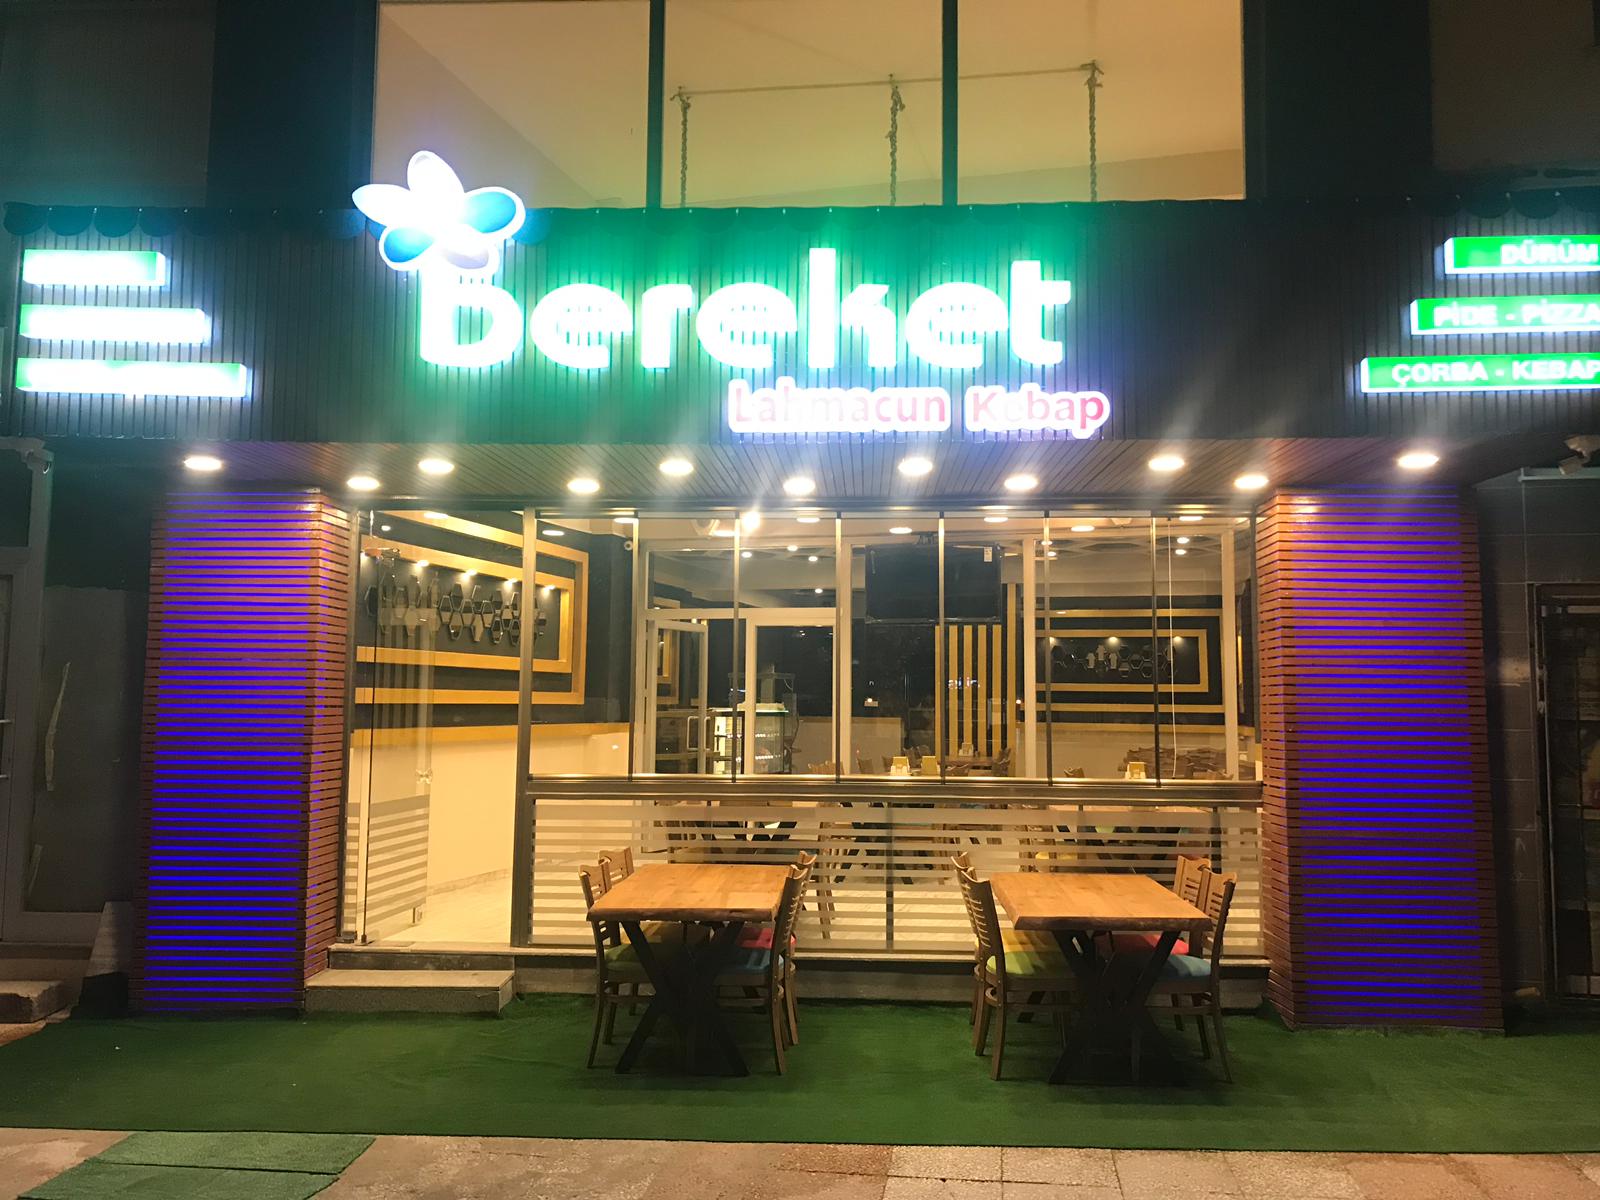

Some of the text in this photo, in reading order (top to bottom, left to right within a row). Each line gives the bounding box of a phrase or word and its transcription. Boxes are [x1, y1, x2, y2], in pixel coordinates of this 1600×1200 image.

[1500, 239, 1599, 265] DÜRÜM
[419, 248, 1073, 370] bereket
[1433, 301, 1498, 327] PİDE
[1520, 299, 1600, 326] PİZZA
[1391, 361, 1489, 388] ÇORBA
[734, 384, 1106, 431] Lahmacun Kebap
